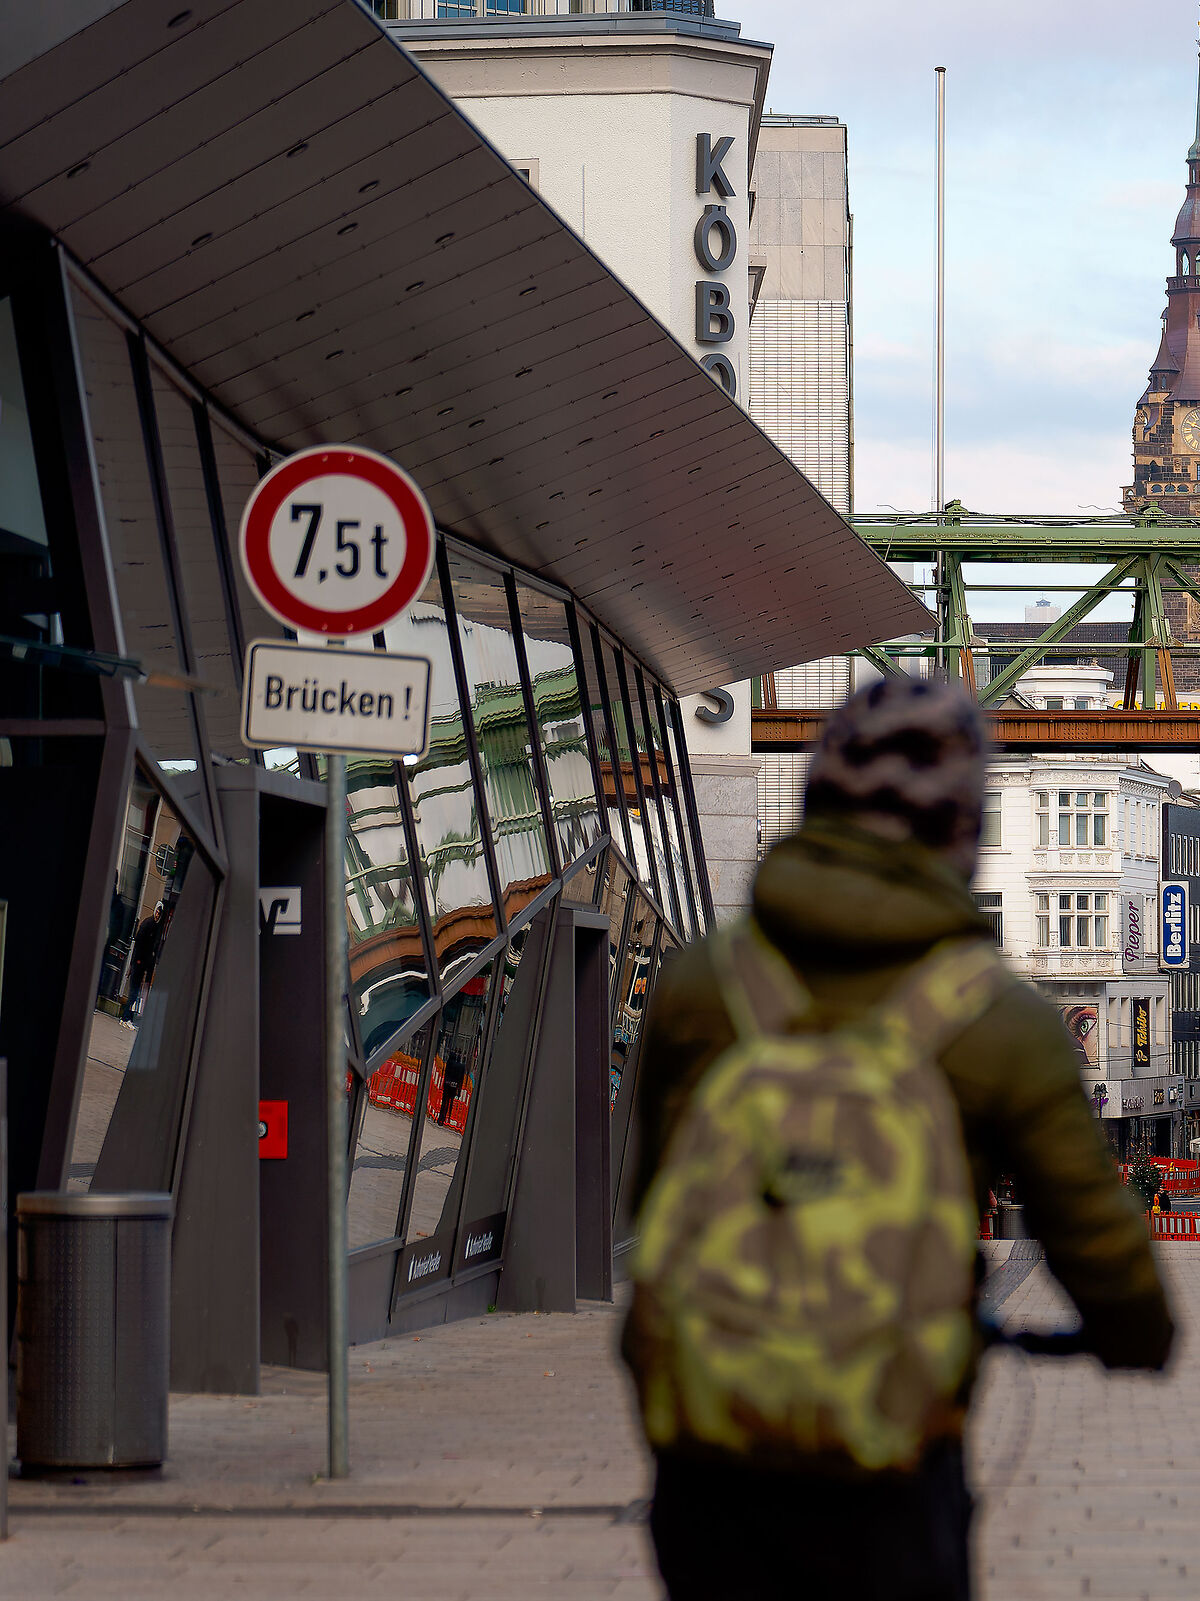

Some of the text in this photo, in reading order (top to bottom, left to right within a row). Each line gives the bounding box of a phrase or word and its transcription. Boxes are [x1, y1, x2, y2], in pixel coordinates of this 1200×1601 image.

[264, 675, 394, 719] Brücken
[1124, 900, 1142, 962] Pieper
[1164, 892, 1182, 957] Berlitz
